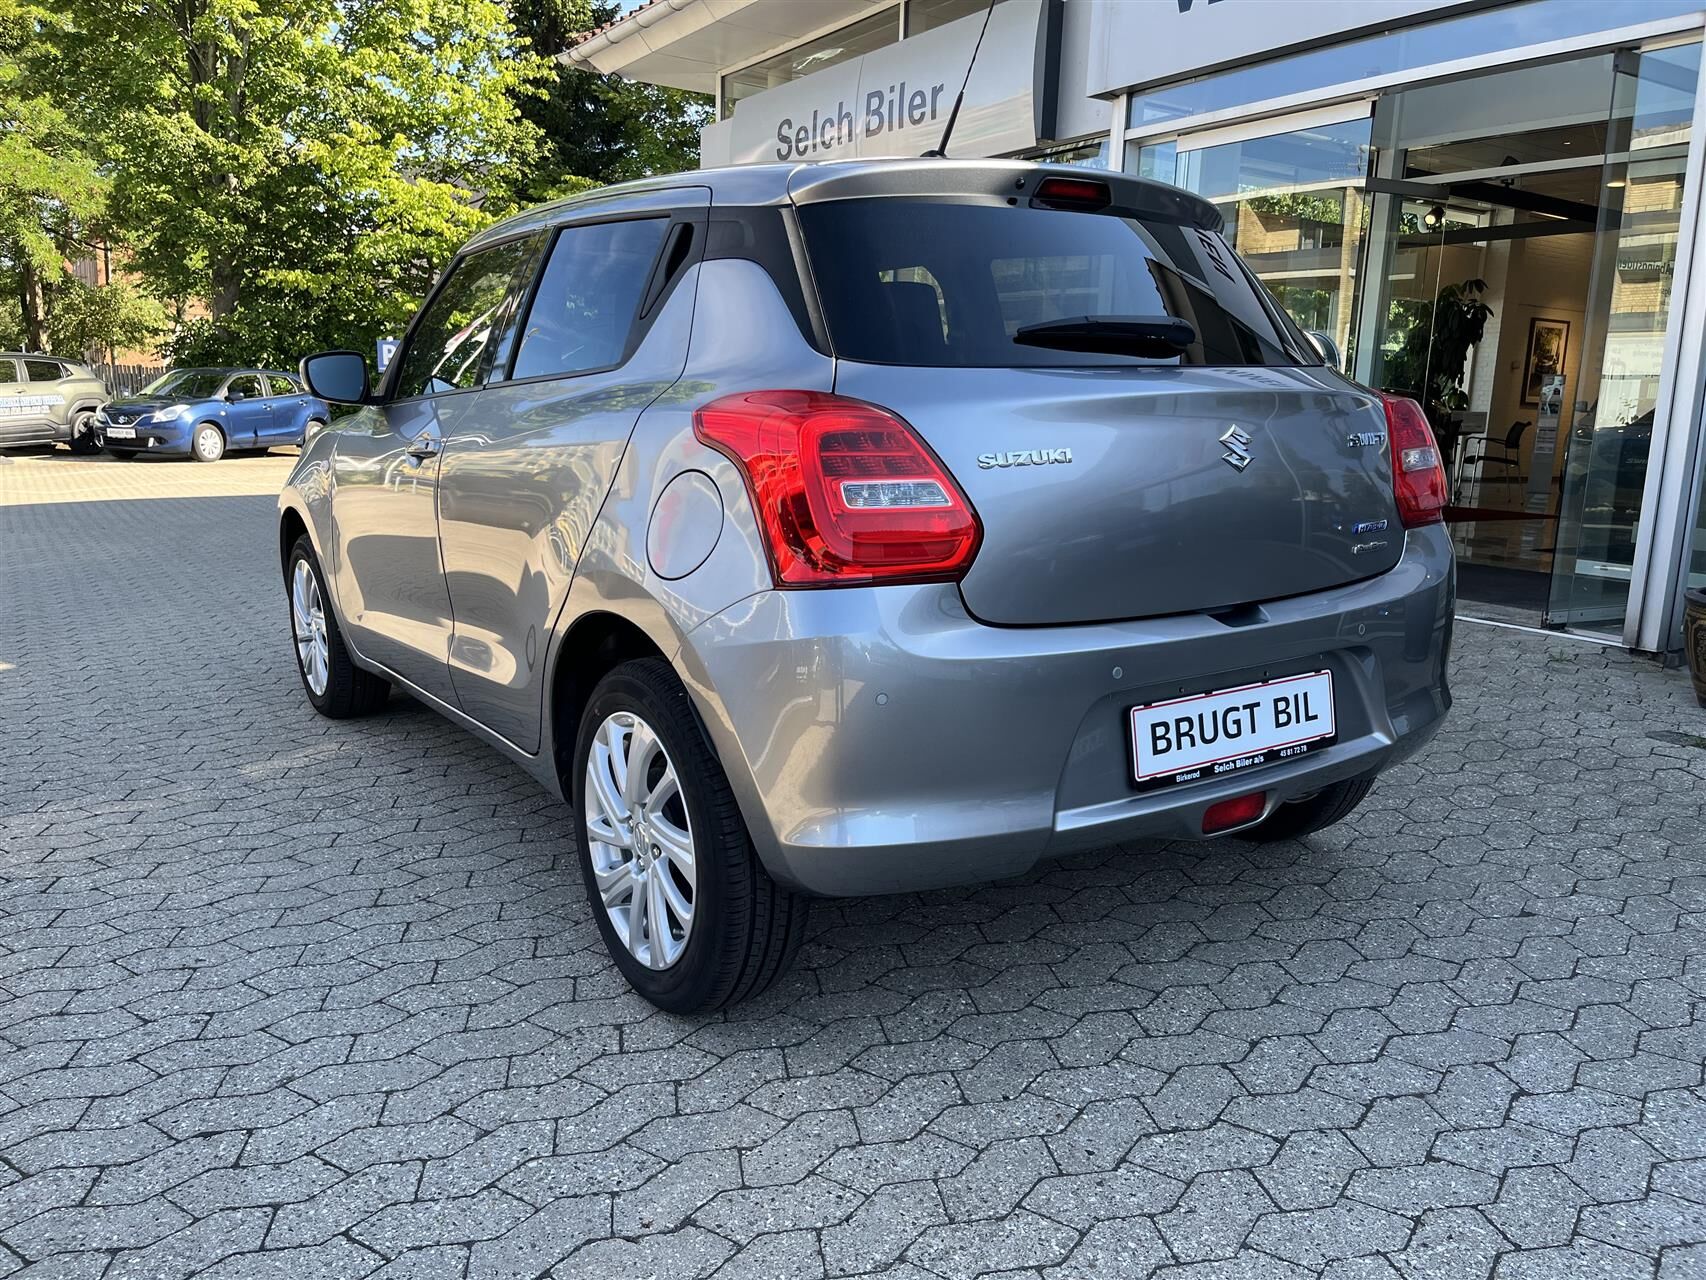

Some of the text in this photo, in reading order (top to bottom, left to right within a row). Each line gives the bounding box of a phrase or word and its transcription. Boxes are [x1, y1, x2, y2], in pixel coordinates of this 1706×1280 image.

[776, 82, 944, 161] Selch Biler
[382, 344, 397, 365] P
[977, 448, 1072, 470] SUZUKI
[1150, 691, 1319, 756] BRUGT BIL
[1214, 763, 1235, 774] Selch
[1236, 758, 1253, 768] Biler
